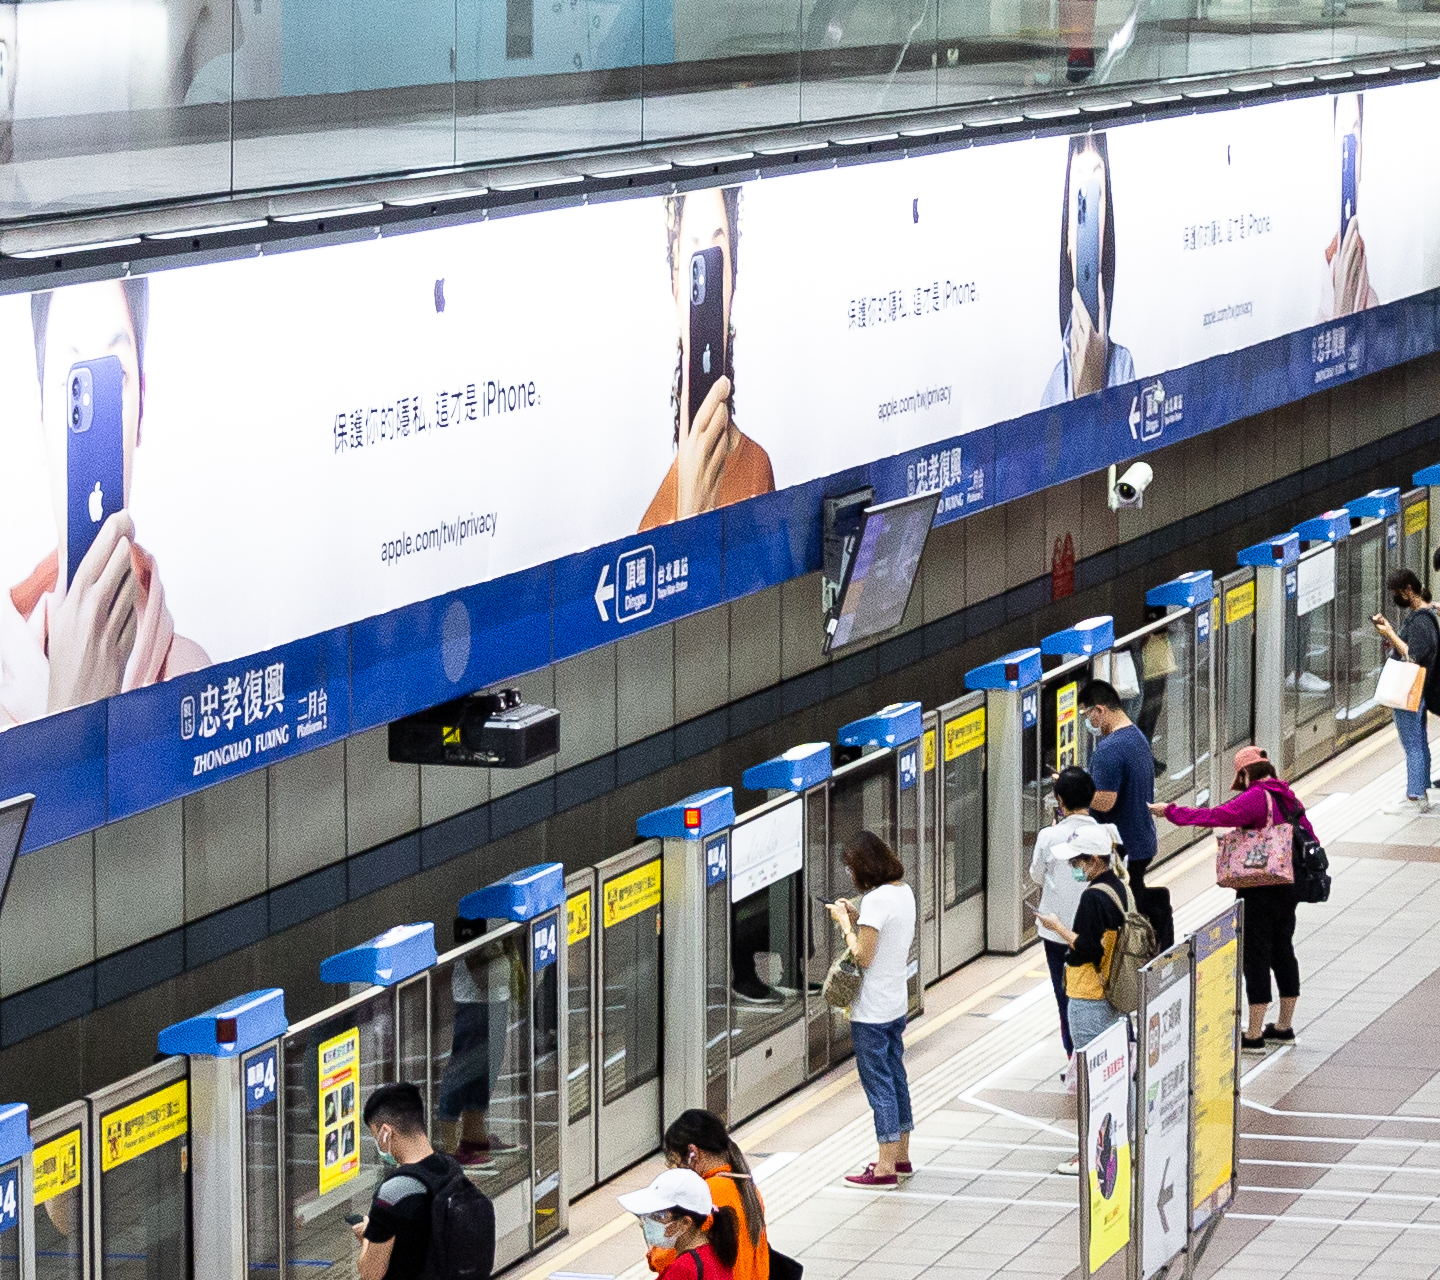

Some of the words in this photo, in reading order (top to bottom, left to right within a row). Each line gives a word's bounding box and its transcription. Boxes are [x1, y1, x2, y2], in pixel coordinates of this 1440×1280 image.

[381, 511, 497, 566] apple.com/tw/privacy
[199, 662, 285, 738] 忠孝復興
[297, 687, 327, 721] 二月台
[193, 737, 252, 777] ZHONGXIAO
[255, 724, 289, 754] FUXING
[718, 843, 726, 872] 4
[547, 923, 557, 955] 4
[264, 1056, 276, 1093] 4
[3, 1179, 16, 1218] 4
